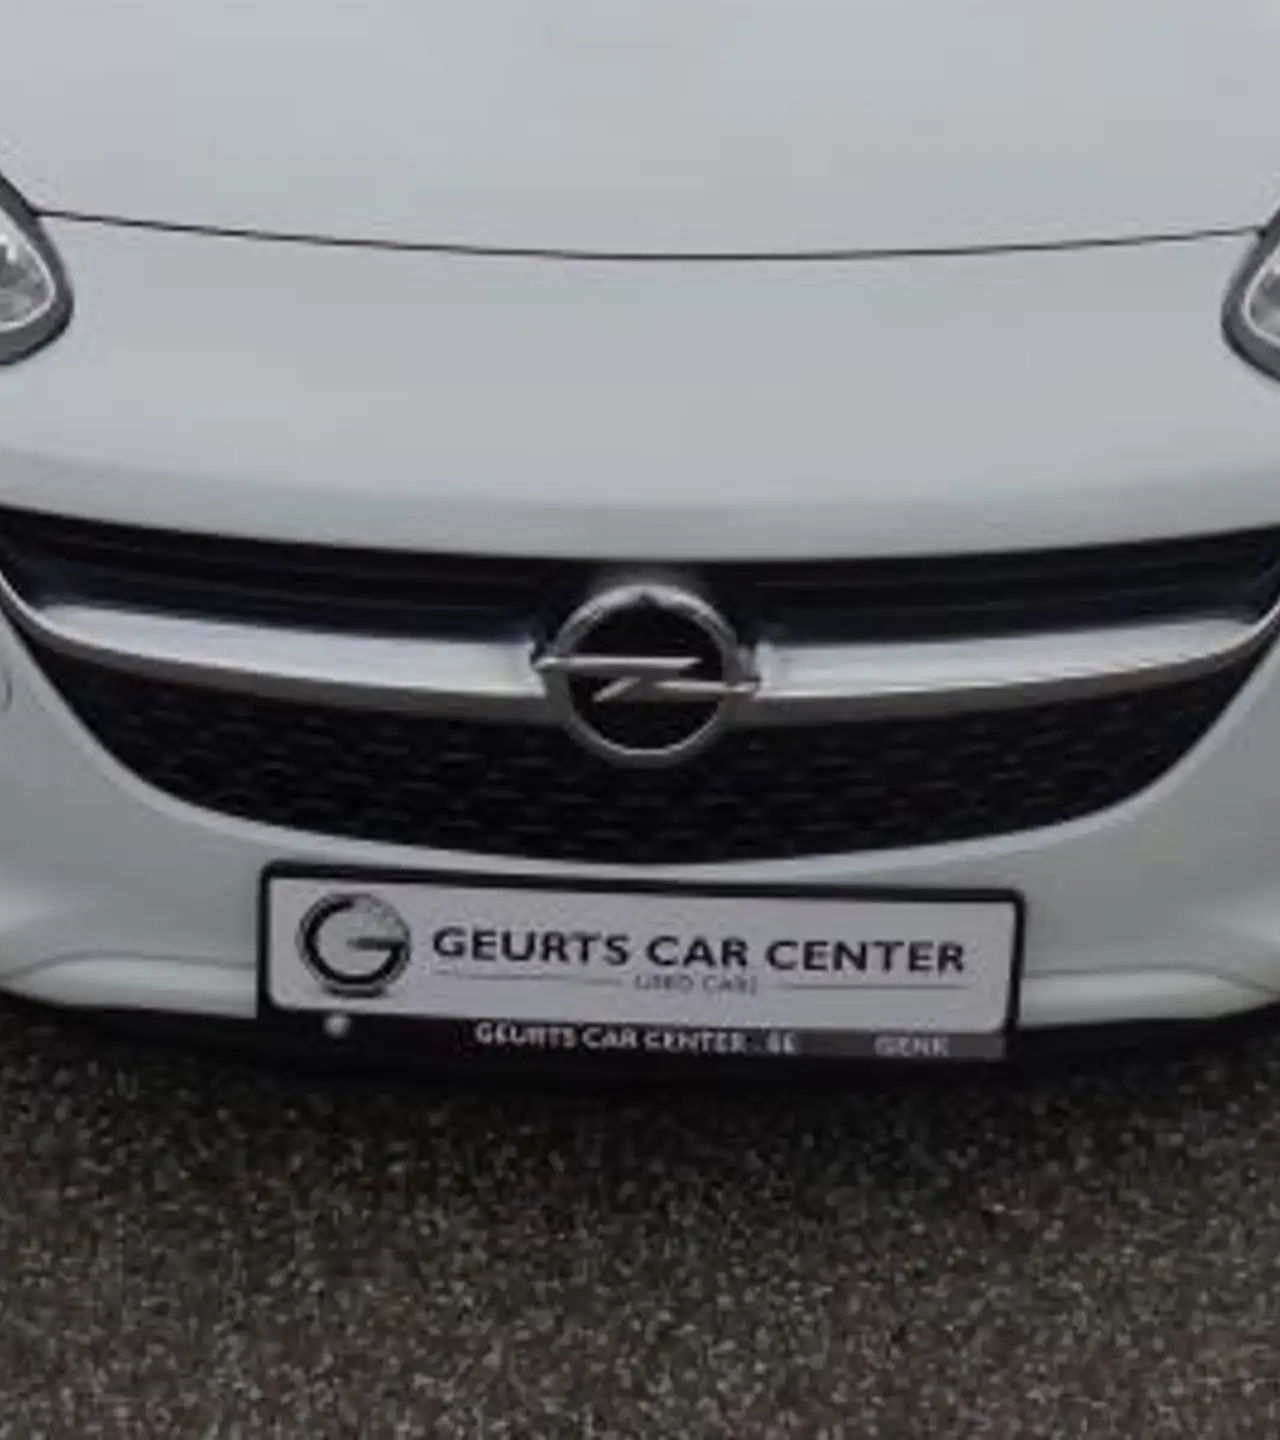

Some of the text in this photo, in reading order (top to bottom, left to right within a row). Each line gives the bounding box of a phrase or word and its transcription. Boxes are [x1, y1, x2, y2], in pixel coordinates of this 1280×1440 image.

[432, 926, 966, 973] GEURTS CAR CENTER
[581, 1026, 639, 1051] CAR
[643, 1029, 748, 1054] CENTER
